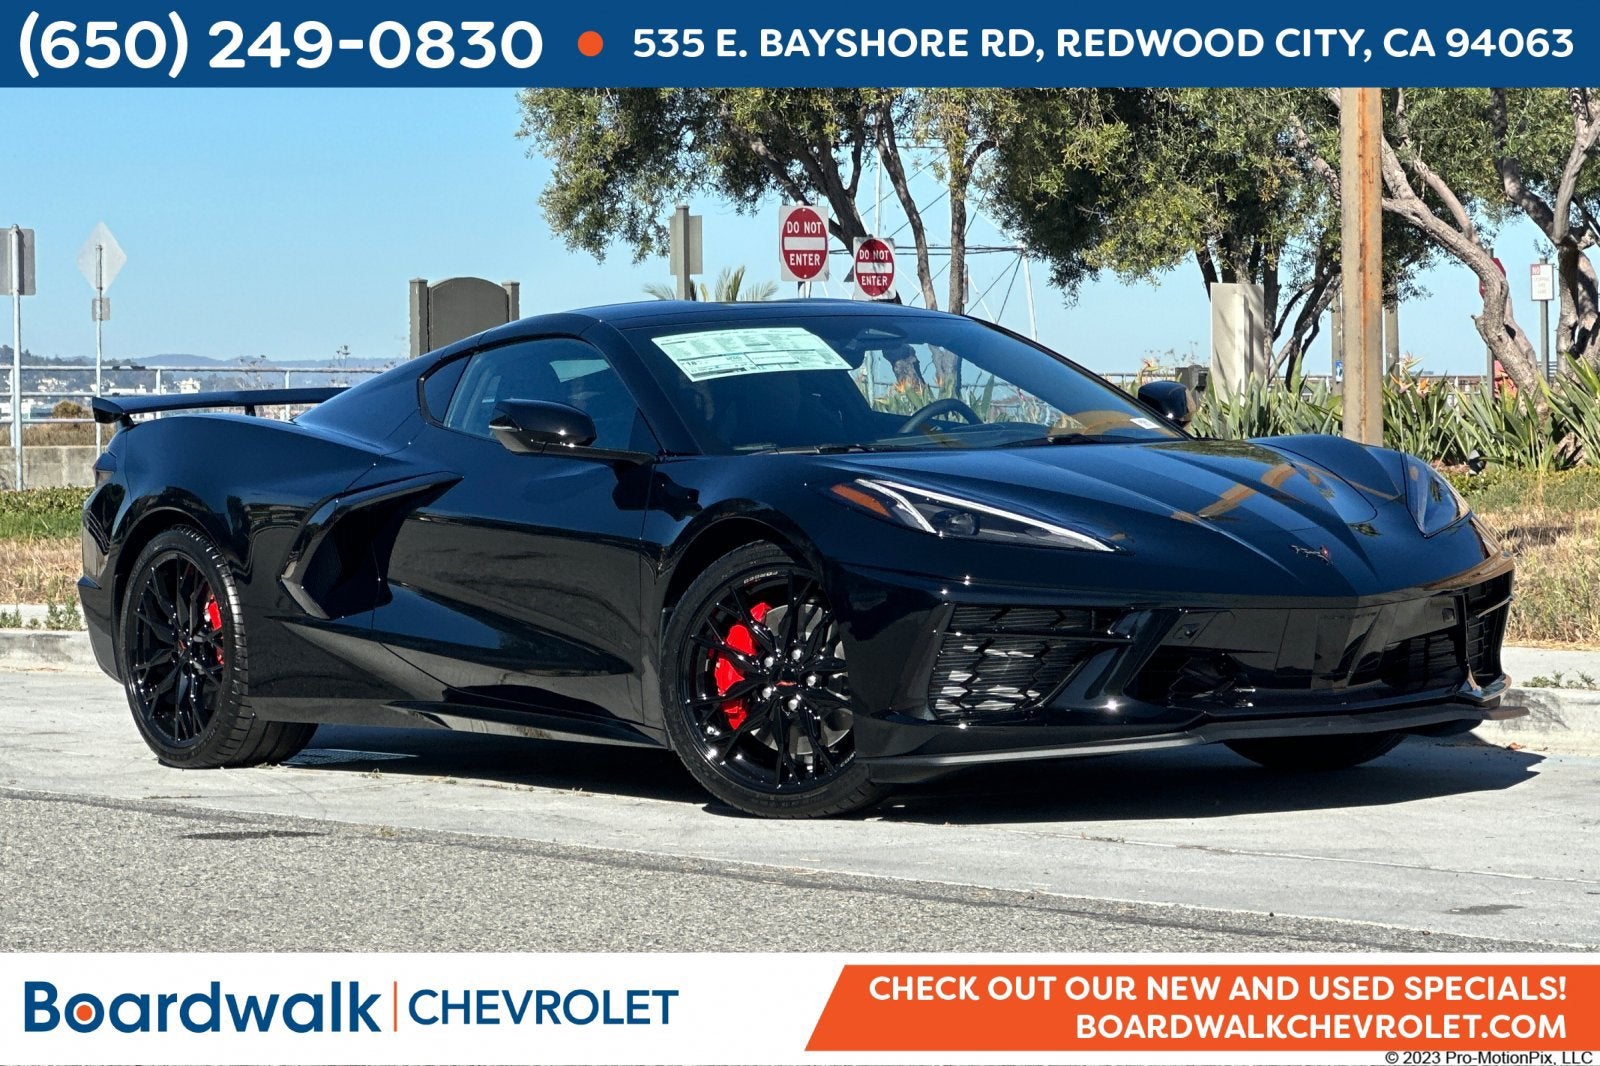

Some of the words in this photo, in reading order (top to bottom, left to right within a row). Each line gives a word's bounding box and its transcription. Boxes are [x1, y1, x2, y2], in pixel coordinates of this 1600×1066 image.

[787, 221, 800, 234] DO
[803, 221, 822, 234] NOT
[789, 253, 821, 266] ENTER
[859, 249, 870, 260] DO
[873, 250, 890, 260] NOT
[861, 275, 888, 286] ENTER
